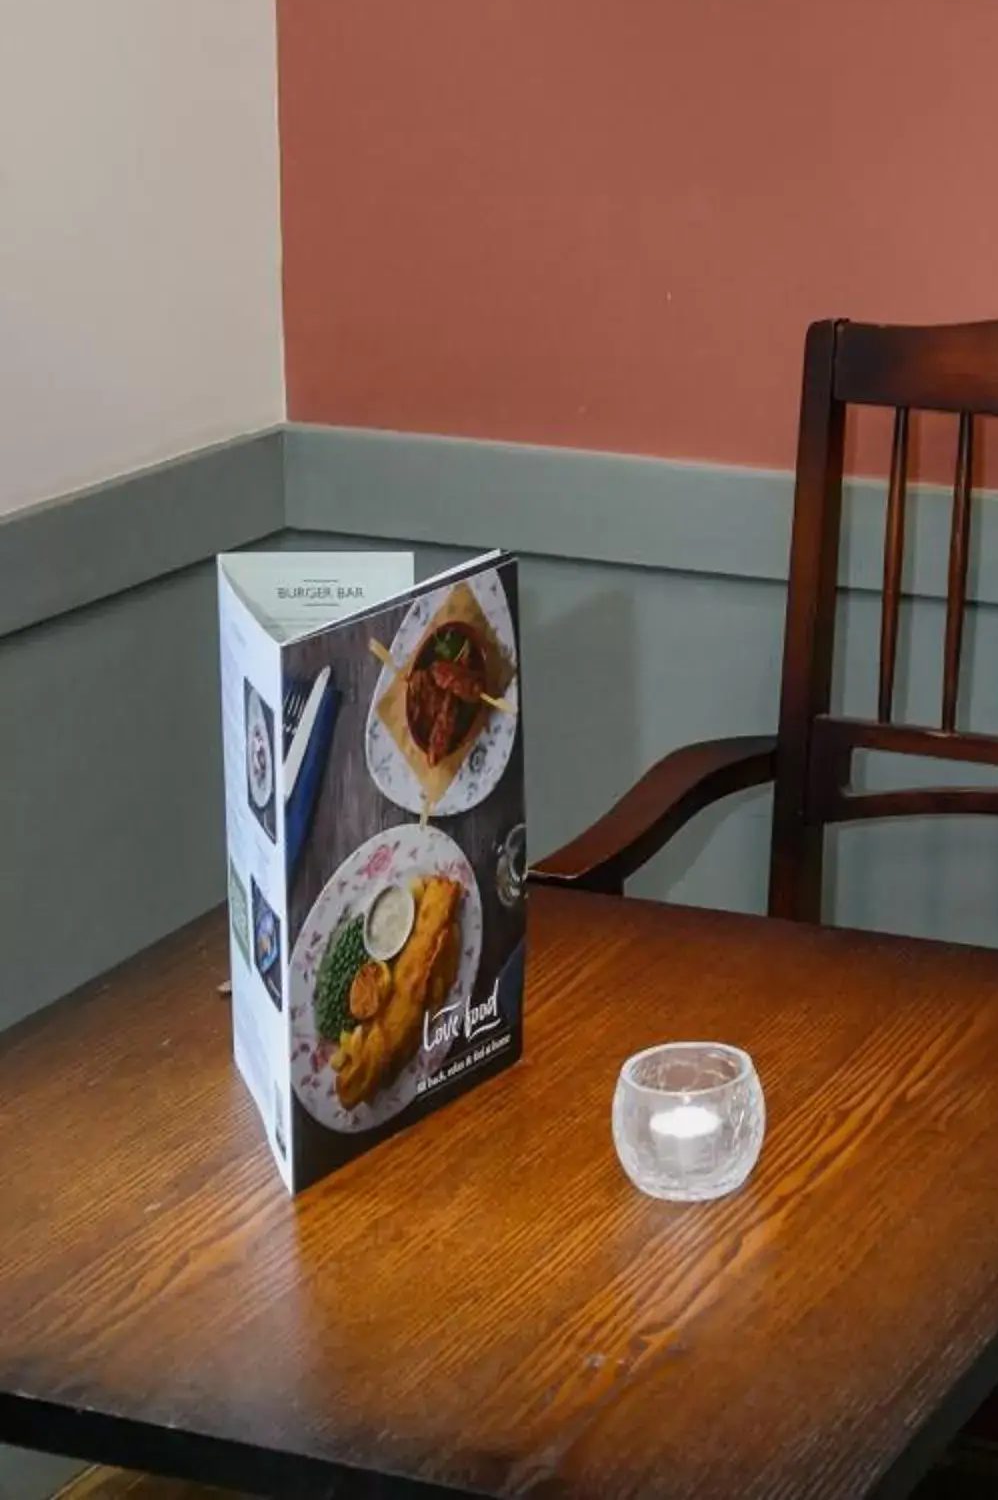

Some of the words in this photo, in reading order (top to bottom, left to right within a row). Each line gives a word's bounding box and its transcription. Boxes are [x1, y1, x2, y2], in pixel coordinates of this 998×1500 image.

[276, 586, 334, 600] BURGER
[336, 587, 365, 600] BAR
[424, 1000, 462, 1051] Love
